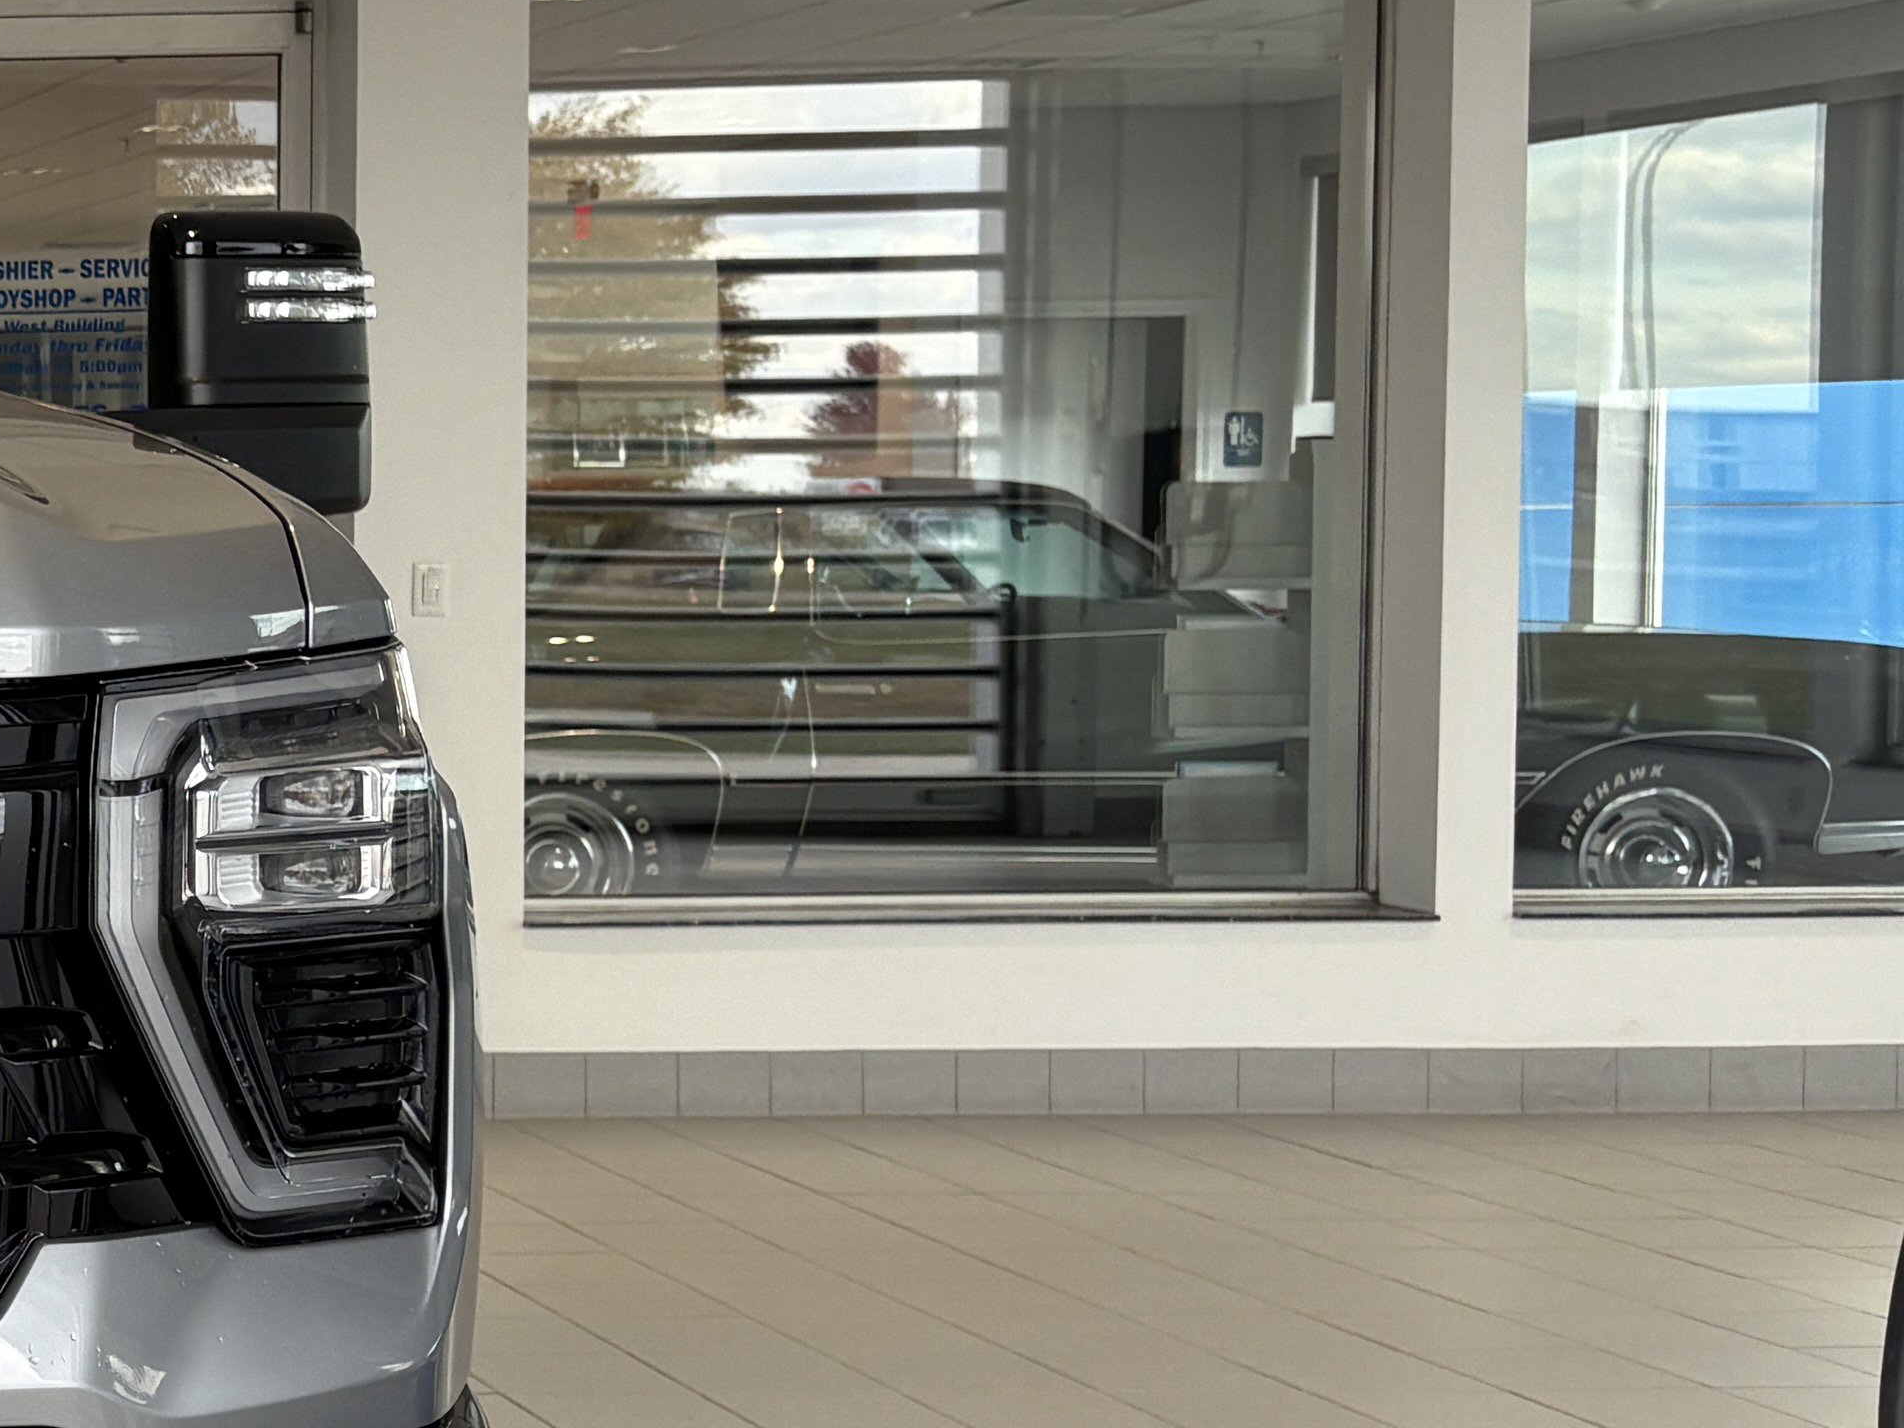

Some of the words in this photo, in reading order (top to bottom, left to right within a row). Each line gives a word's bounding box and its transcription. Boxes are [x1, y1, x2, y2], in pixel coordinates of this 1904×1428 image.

[53, 317, 126, 334] Building
[96, 336, 144, 353] Frida
[1560, 763, 1665, 851] FIREHAWK
